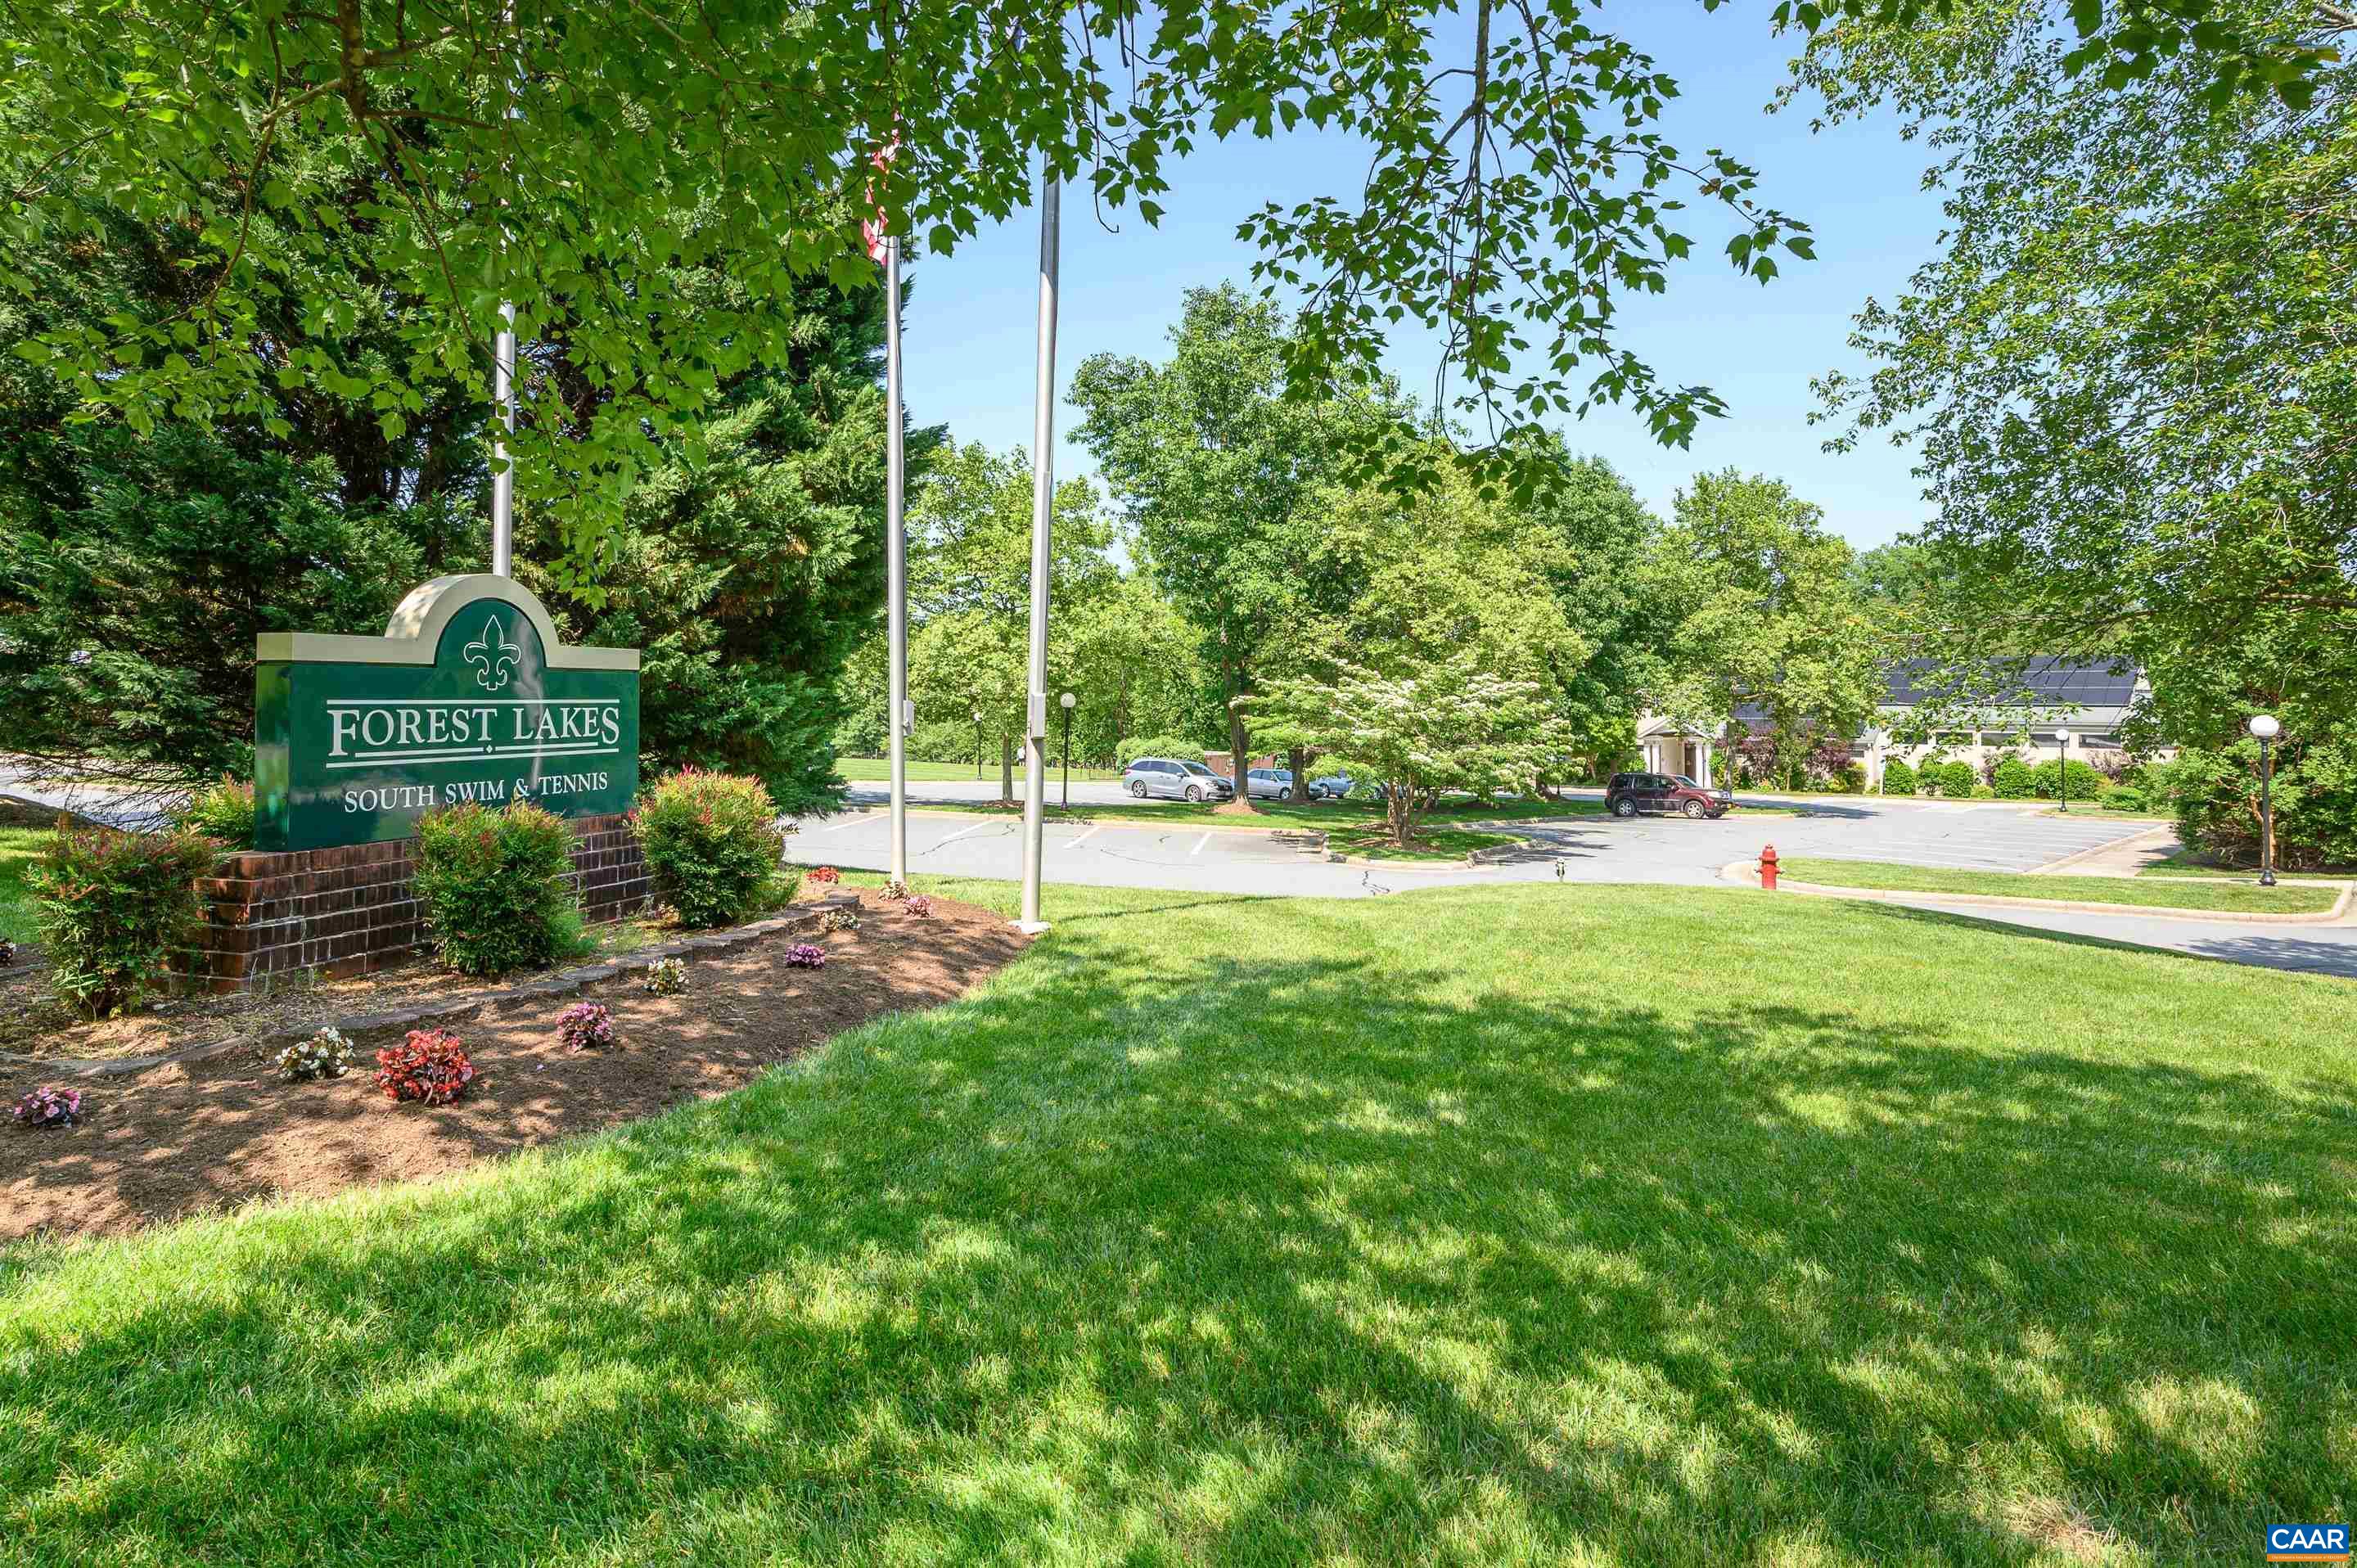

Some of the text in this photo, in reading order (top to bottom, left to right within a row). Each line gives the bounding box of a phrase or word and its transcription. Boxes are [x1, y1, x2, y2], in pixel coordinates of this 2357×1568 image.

[327, 706, 620, 757] FOREST LAKES
[344, 772, 608, 813] SOUTH SWIM & TENNIS
